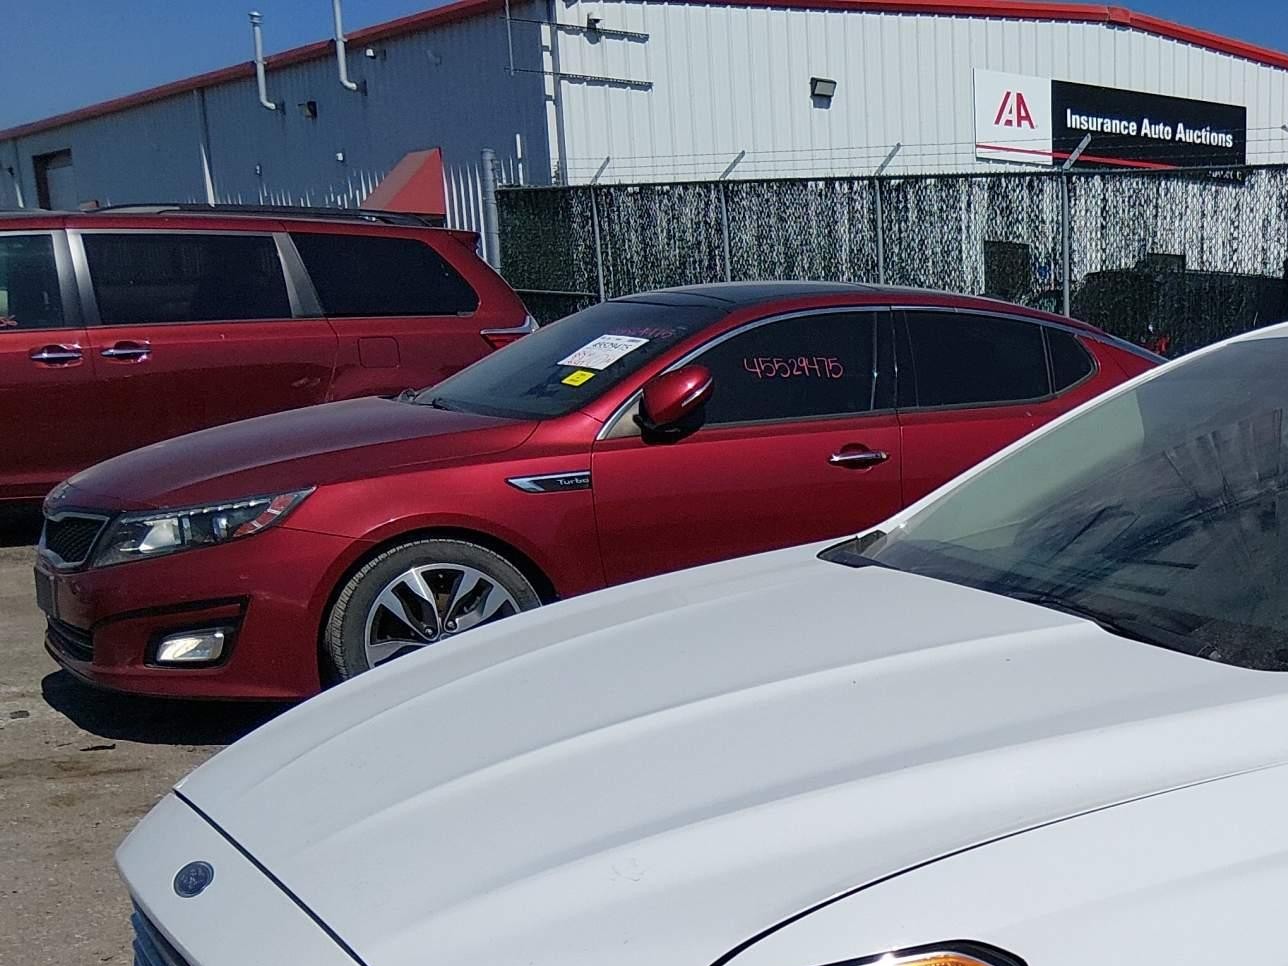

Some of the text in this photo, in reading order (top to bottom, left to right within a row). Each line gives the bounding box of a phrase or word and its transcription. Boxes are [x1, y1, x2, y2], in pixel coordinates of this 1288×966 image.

[1066, 109, 1233, 148] Insurance Auto Auctions
[743, 356, 844, 379] 45529475
[556, 477, 590, 485] Turbo
